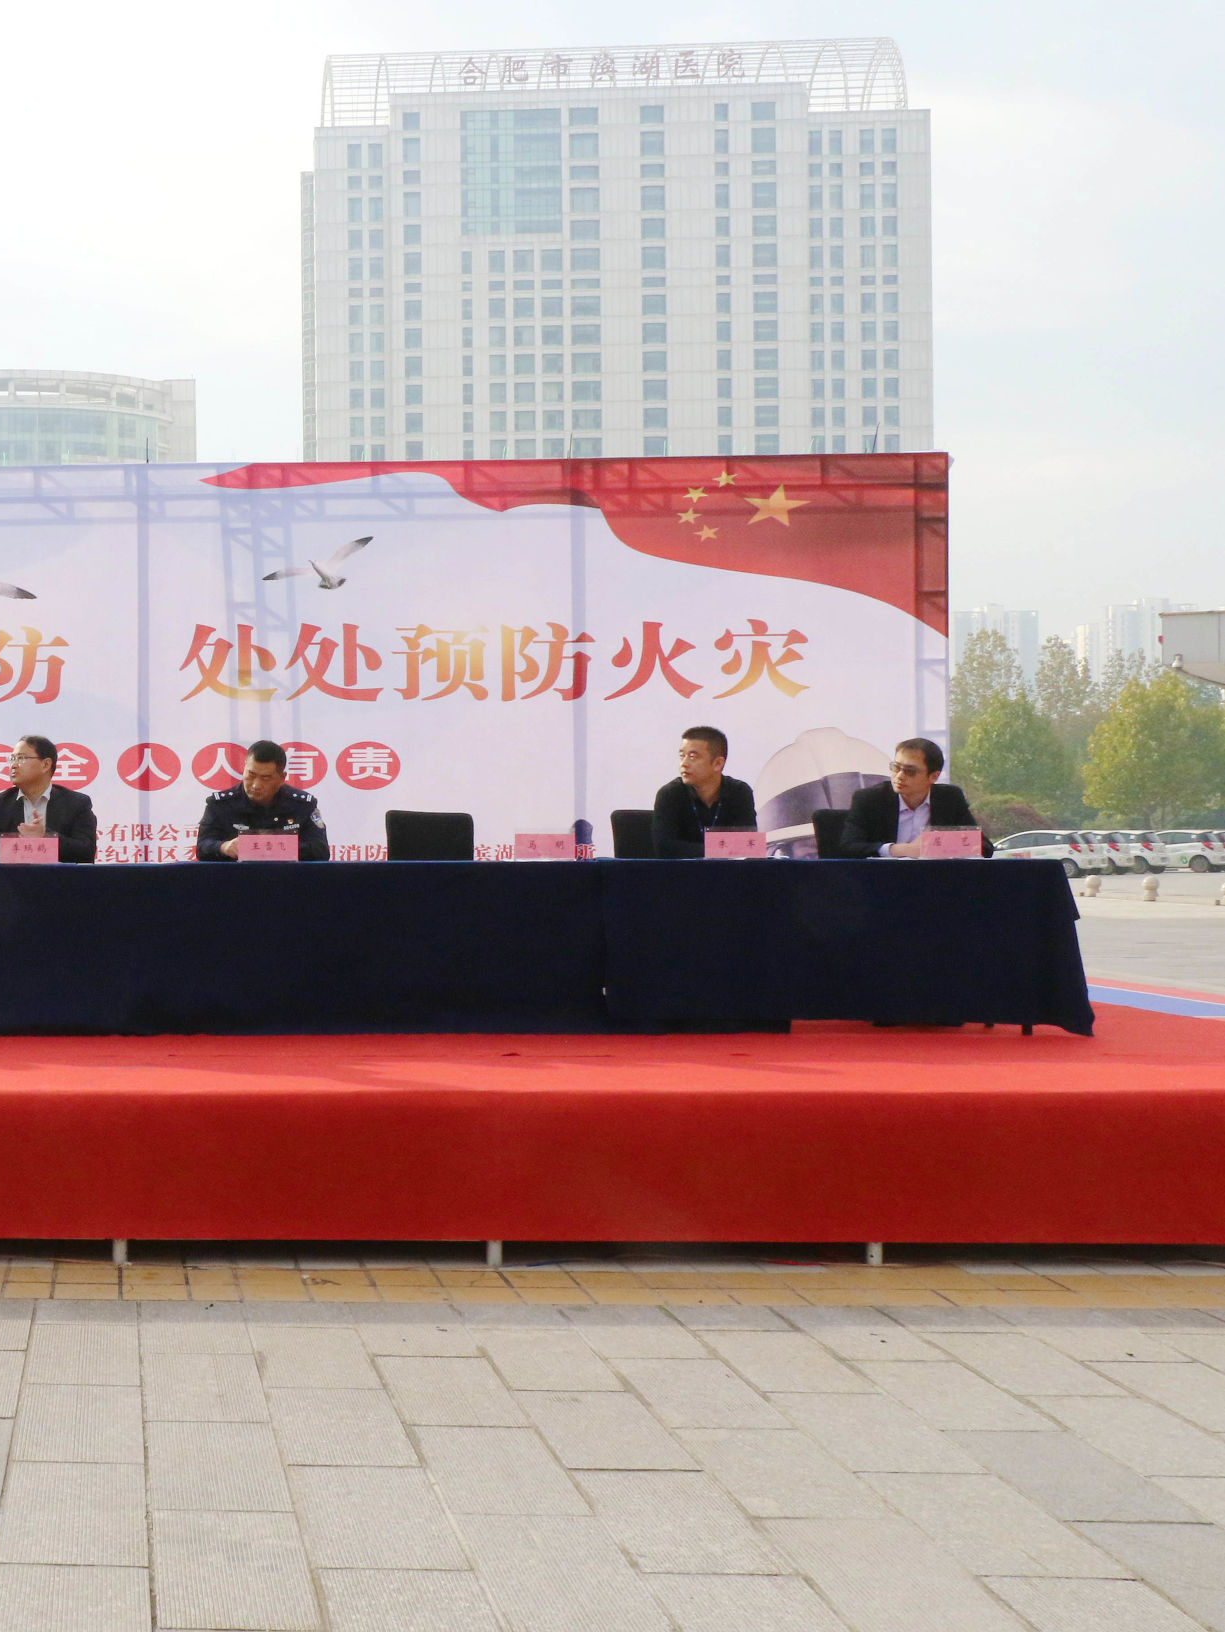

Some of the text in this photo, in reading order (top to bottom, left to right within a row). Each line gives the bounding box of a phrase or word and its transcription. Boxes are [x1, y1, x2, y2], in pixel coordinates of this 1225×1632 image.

[458, 49, 746, 86] 合肥市滨湖医院
[179, 618, 810, 702] 处处预防火灾
